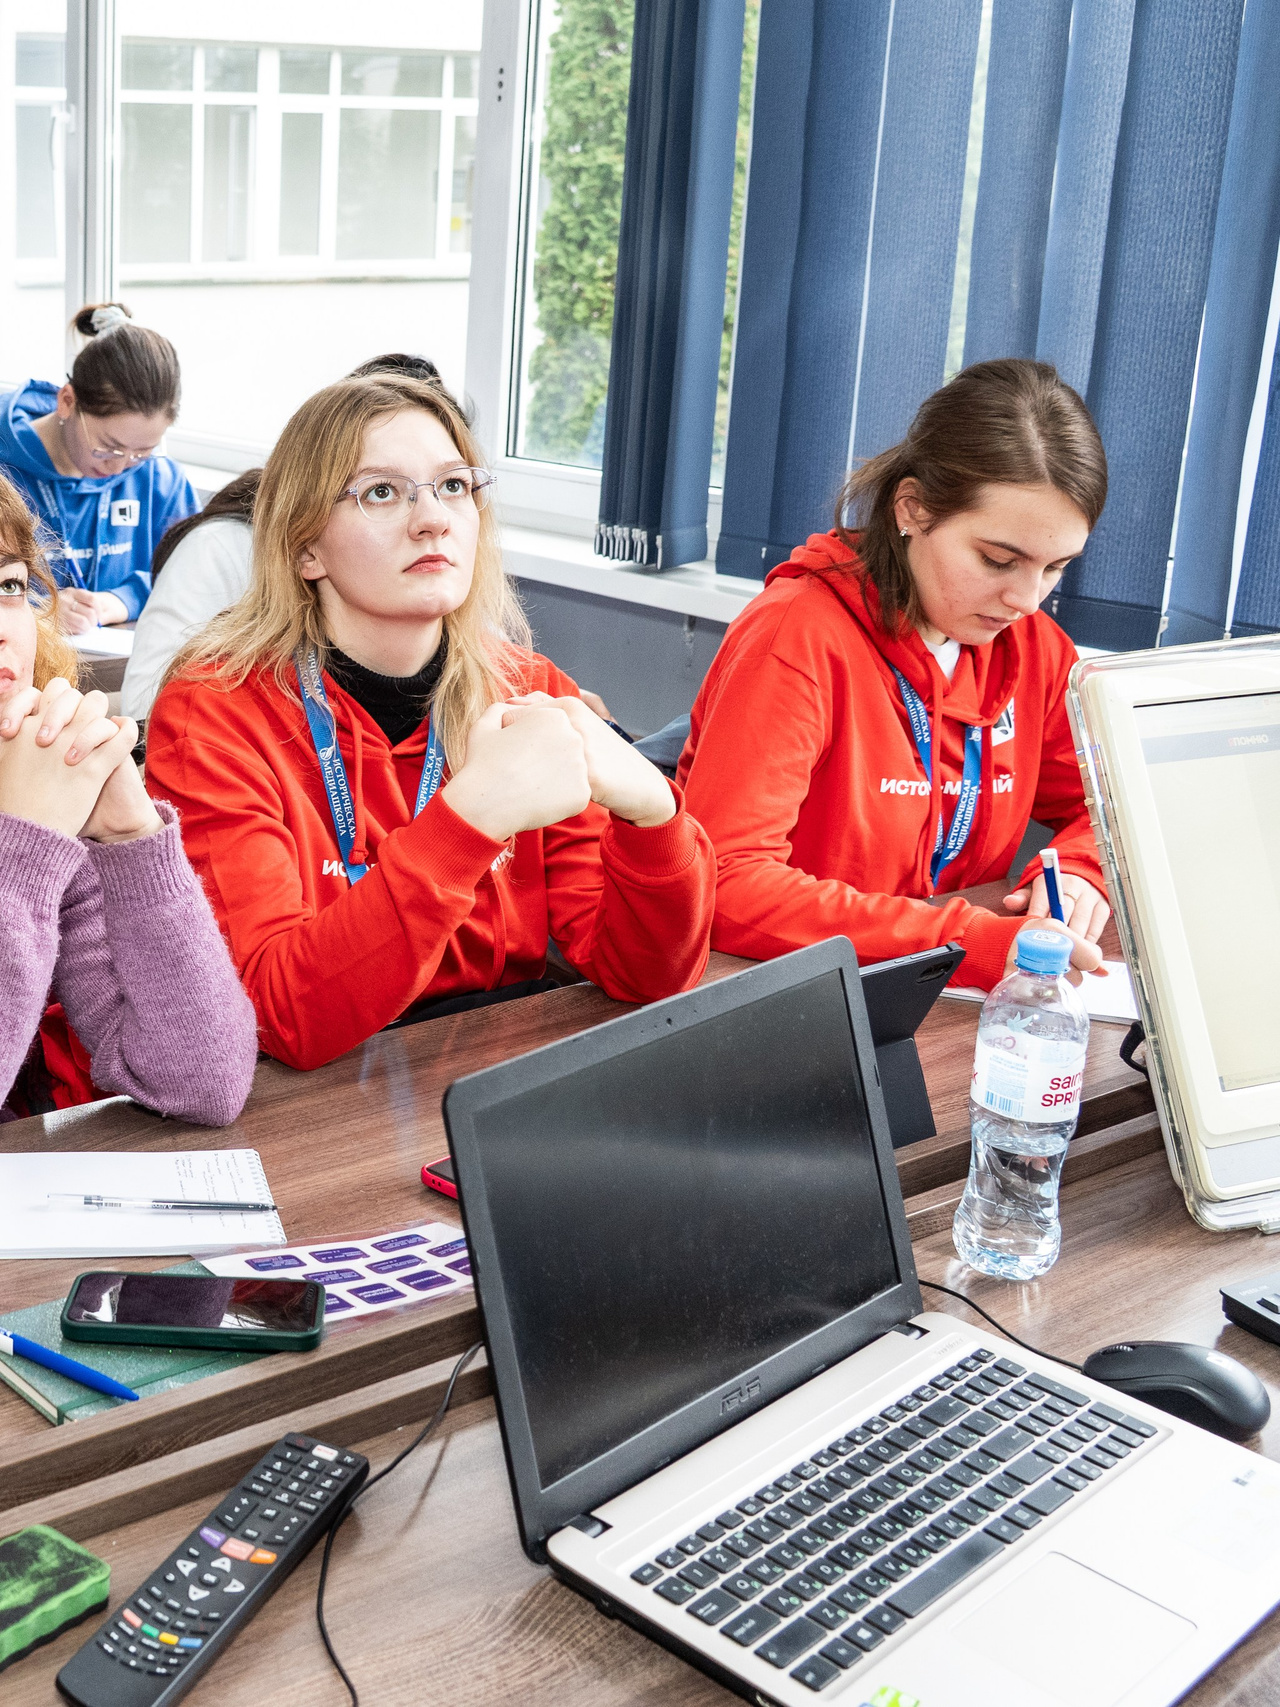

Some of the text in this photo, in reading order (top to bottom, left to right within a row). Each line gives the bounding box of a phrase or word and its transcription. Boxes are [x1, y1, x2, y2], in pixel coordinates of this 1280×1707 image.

[898, 678, 923, 743] МЕДИАШКОЛА
[323, 761, 346, 837] МЕДИАШКОЛА
[333, 758, 357, 839] ИСТОРИЧЕСКАЯ
[417, 748, 436, 815] ТОРИЧЕСКАЯ
[947, 779, 972, 849] ИСТОРИЧЕСКАЯ
[955, 785, 978, 851] МЕДИАШКОЛА
[718, 1376, 762, 1416] ASUS
